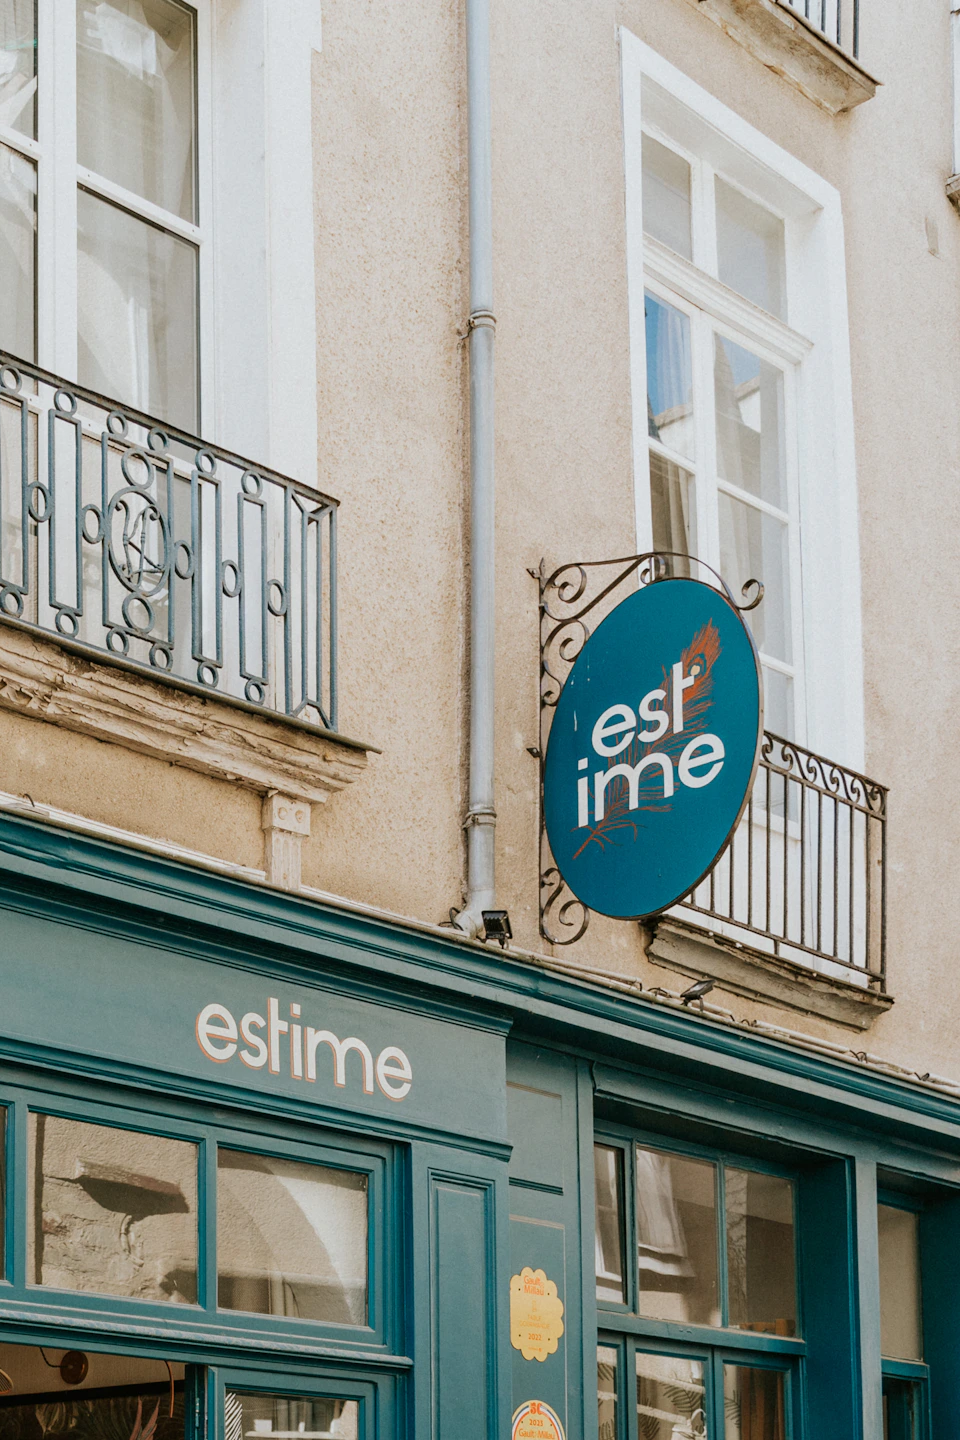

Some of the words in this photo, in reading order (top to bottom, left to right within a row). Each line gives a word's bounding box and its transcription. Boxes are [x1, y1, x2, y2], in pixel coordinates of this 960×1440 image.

[591, 661, 696, 756] est
[577, 732, 725, 828] ime
[195, 997, 413, 1103] estime
[523, 1285, 545, 1296] Millau
[528, 1333, 542, 1341] 2022
